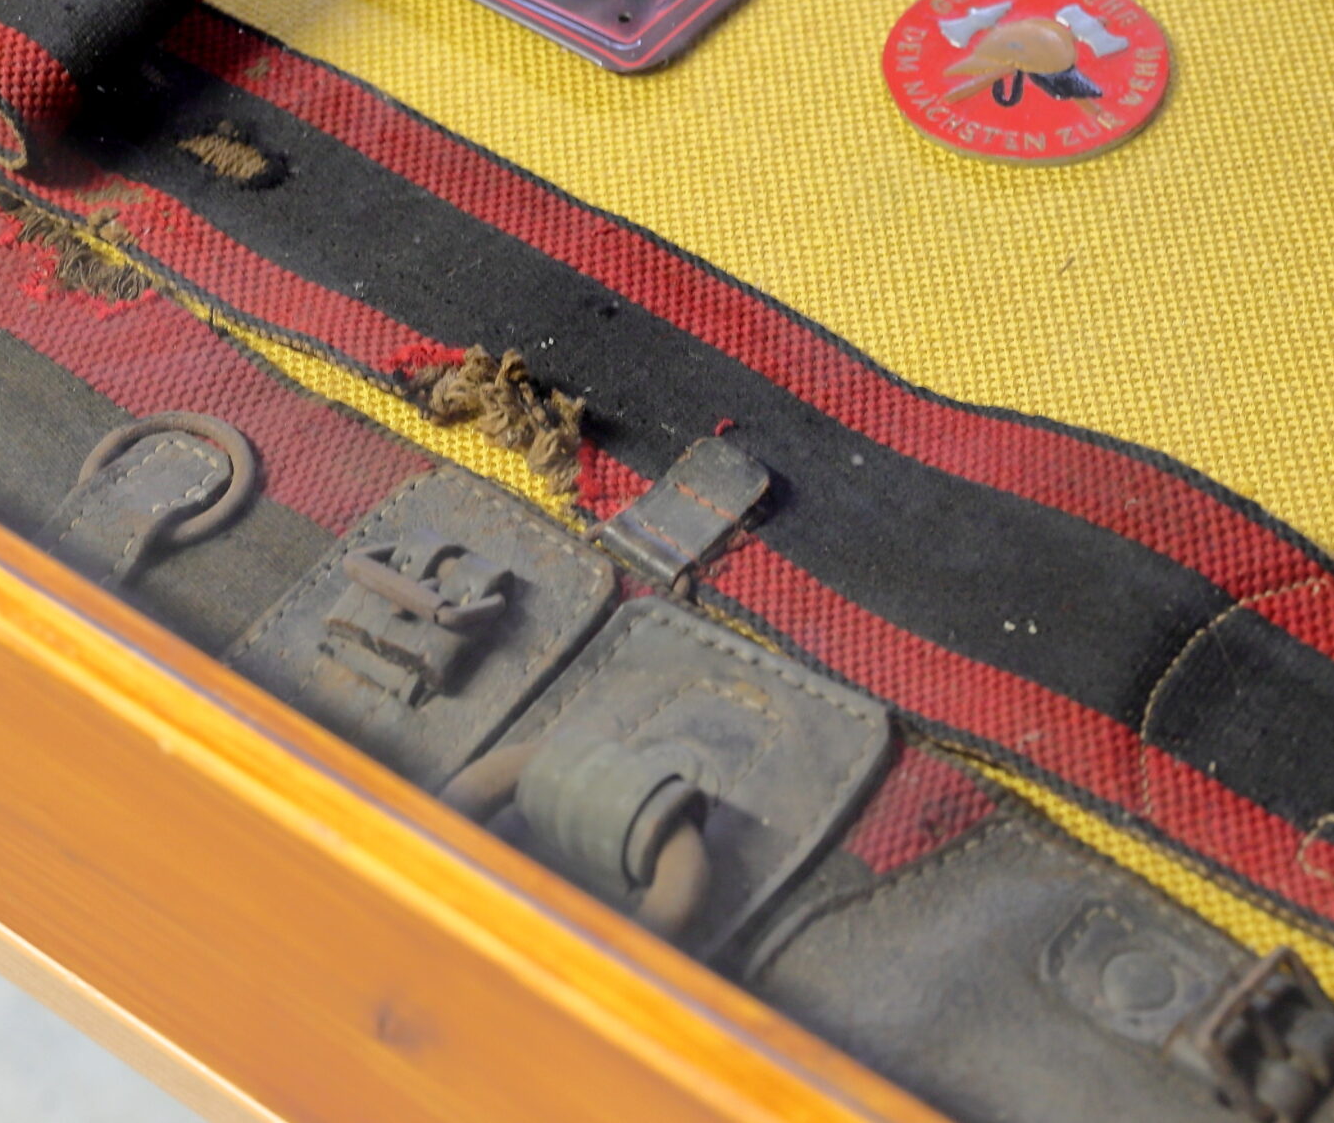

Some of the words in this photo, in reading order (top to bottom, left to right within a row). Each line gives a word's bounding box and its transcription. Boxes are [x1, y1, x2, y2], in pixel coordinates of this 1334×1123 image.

[896, 25, 928, 73] DEM
[1055, 111, 1126, 147] ZUR
[1118, 45, 1164, 106] WEHR
